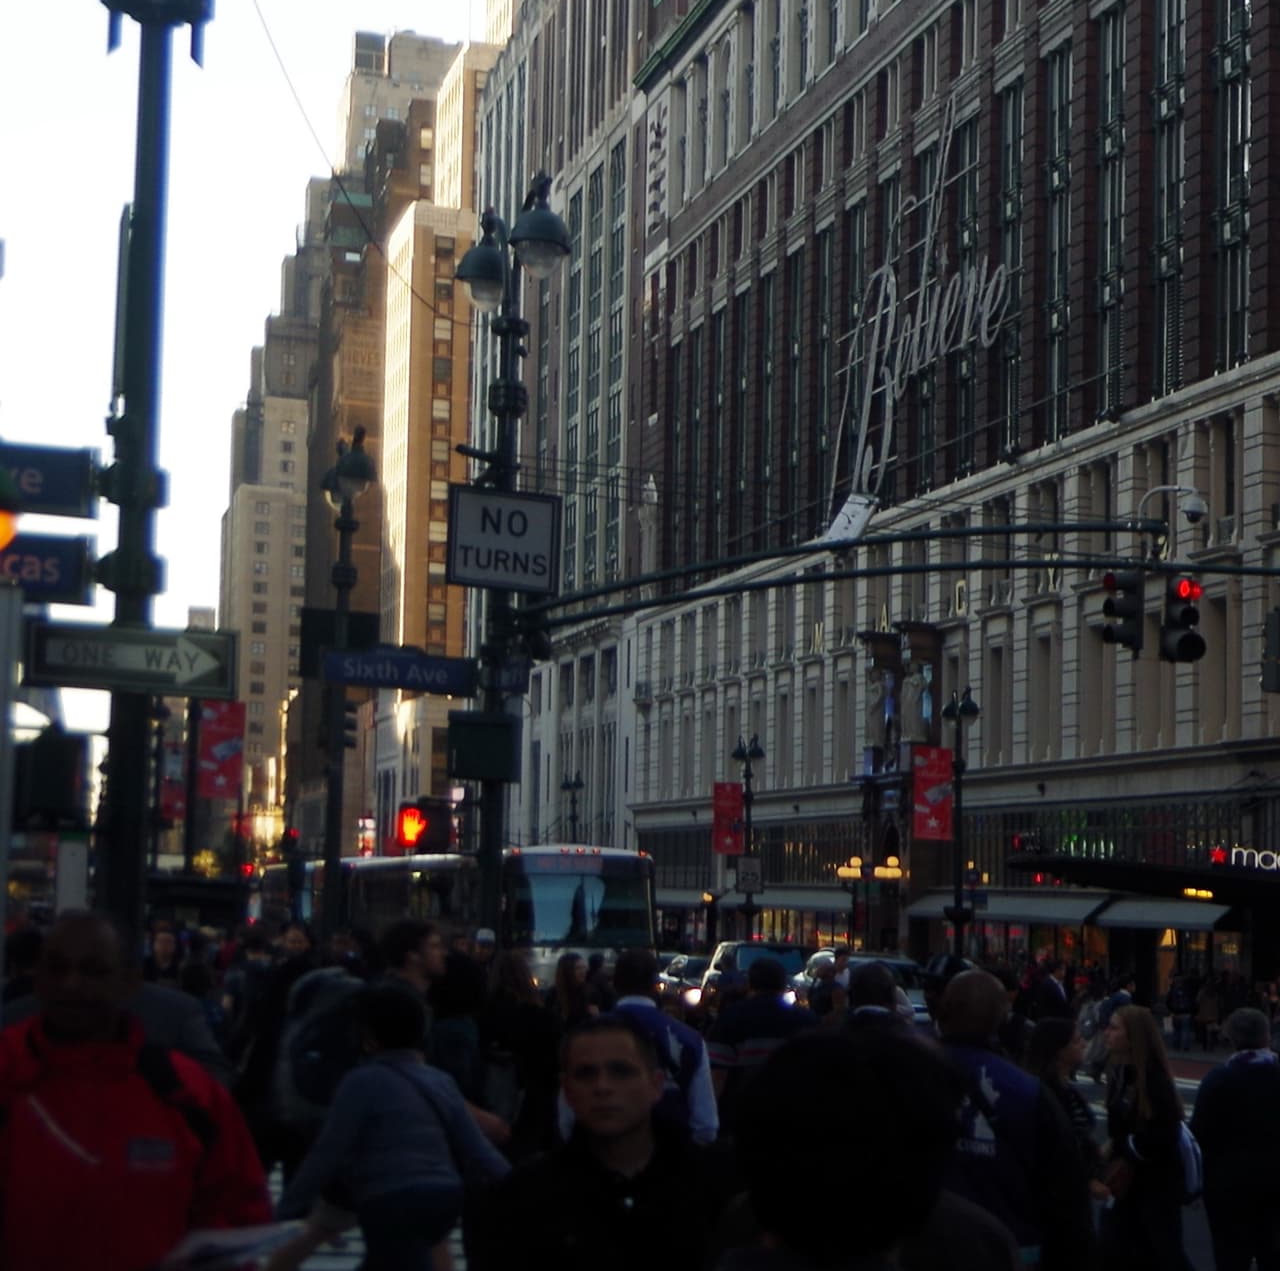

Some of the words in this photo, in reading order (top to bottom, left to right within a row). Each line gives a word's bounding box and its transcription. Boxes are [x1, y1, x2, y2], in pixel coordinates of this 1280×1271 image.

[480, 506, 529, 538] NO
[459, 544, 548, 577] TURNS
[61, 643, 113, 665] ONE
[144, 649, 201, 671] WAY
[343, 656, 399, 681] Sixth
[403, 663, 449, 685] Ave
